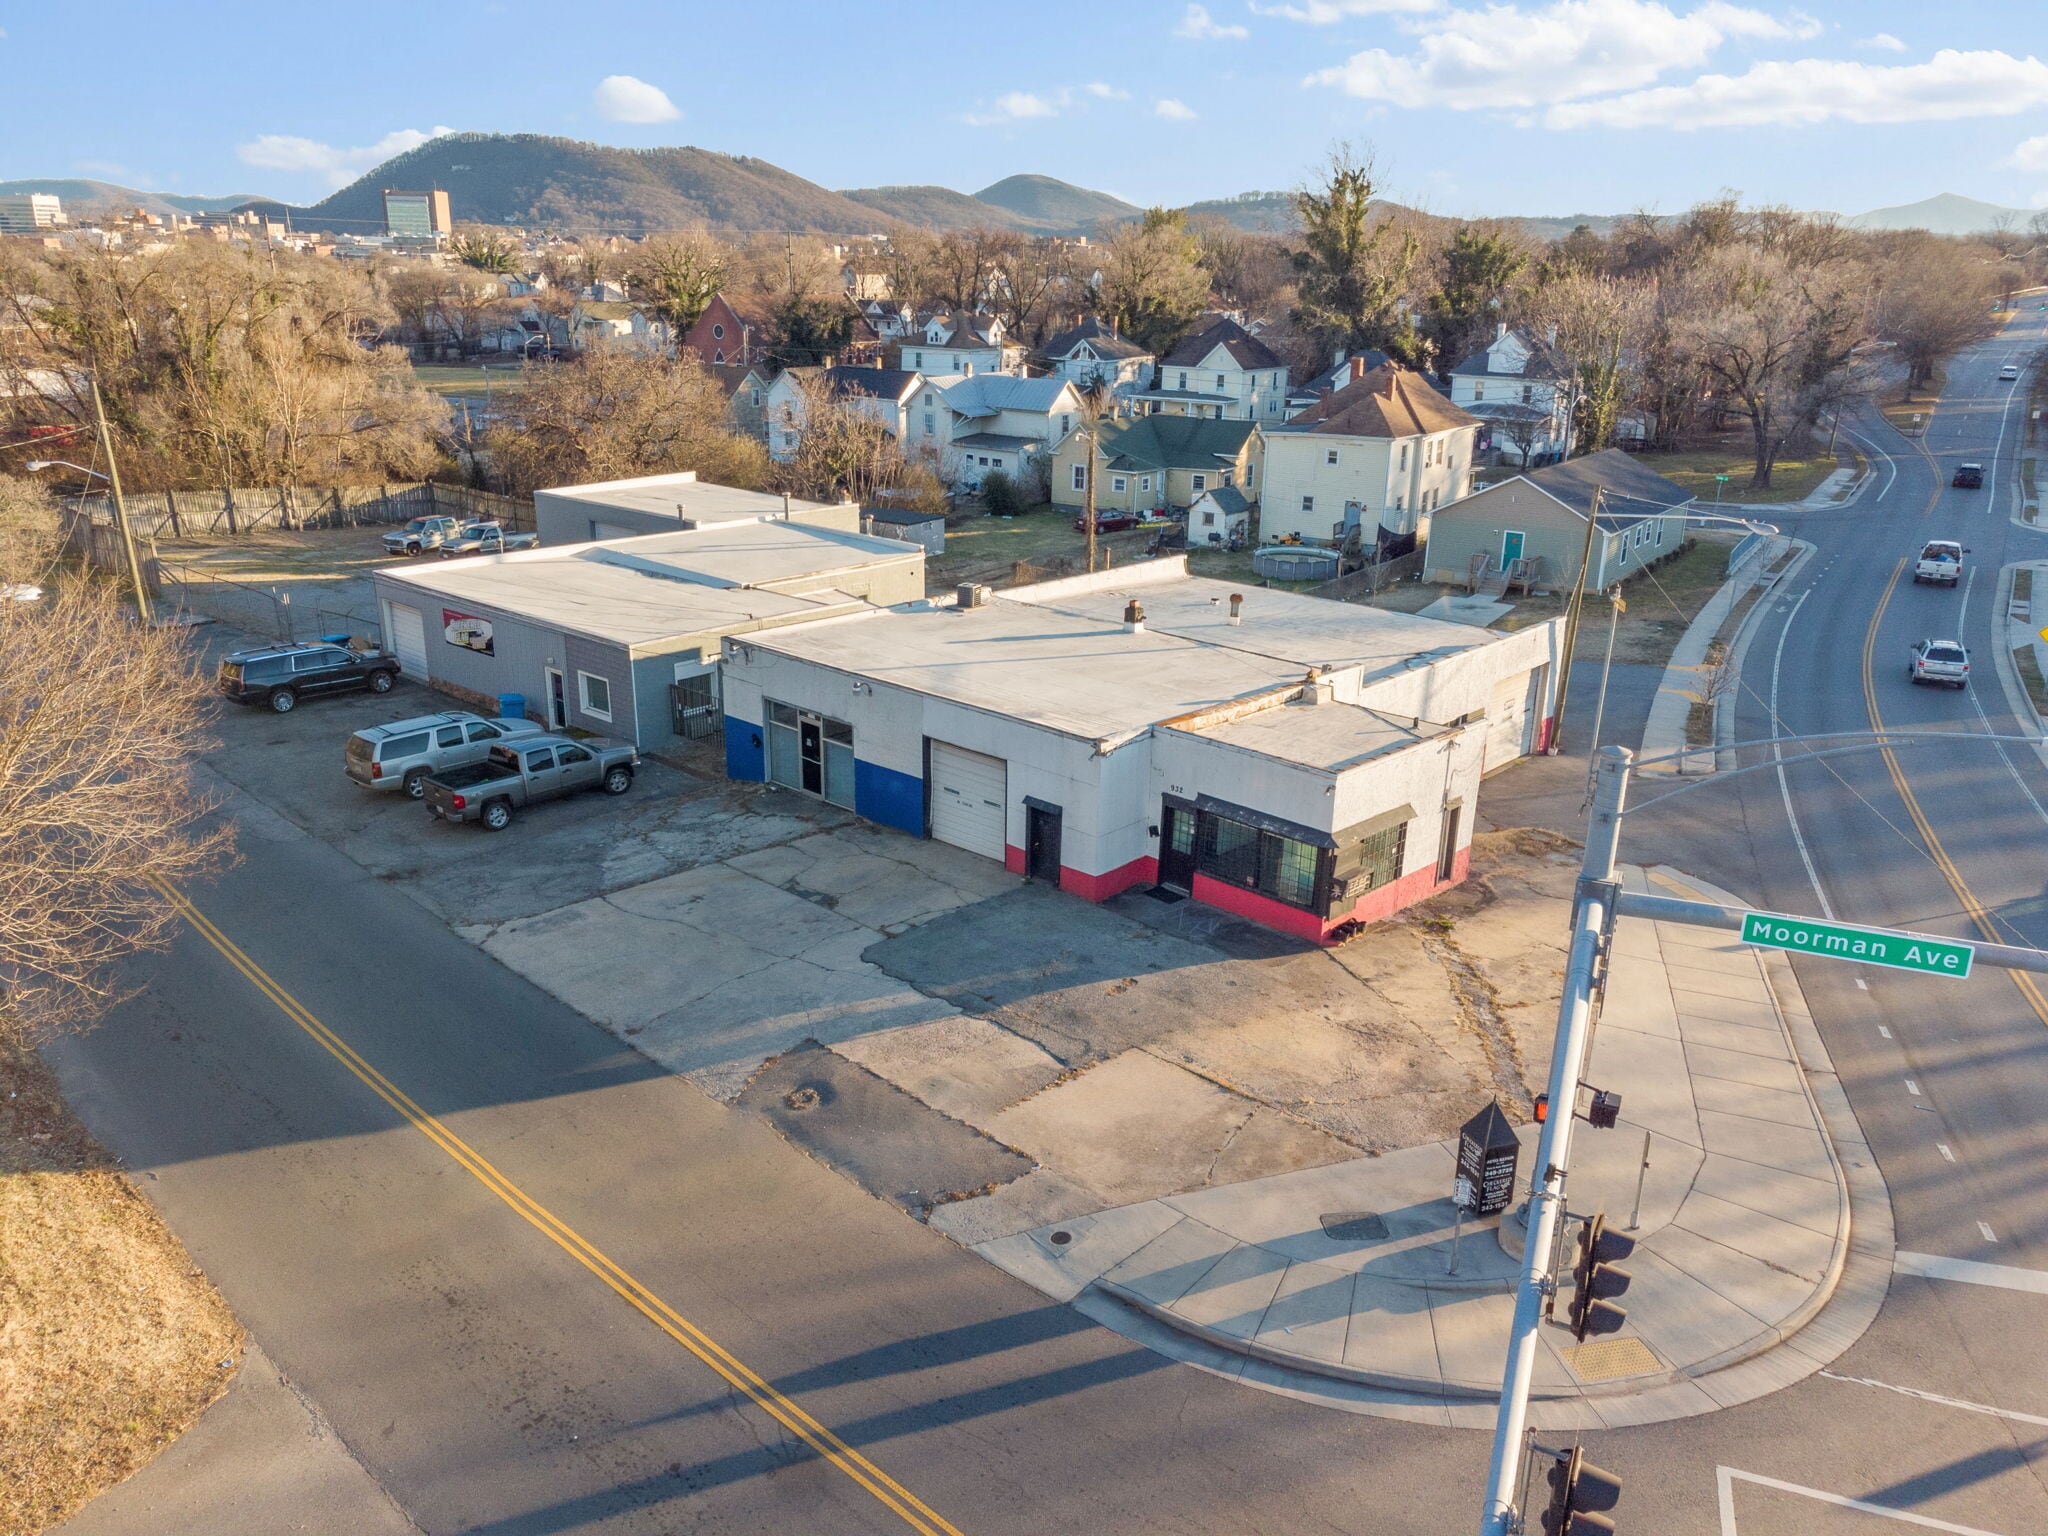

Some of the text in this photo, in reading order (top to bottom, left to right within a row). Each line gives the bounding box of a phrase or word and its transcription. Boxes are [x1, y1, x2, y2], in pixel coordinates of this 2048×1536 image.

[1170, 784, 1184, 794] 932
[1751, 920, 1960, 970] Moorman Ave
[1486, 1185, 1501, 1193] FLAG
